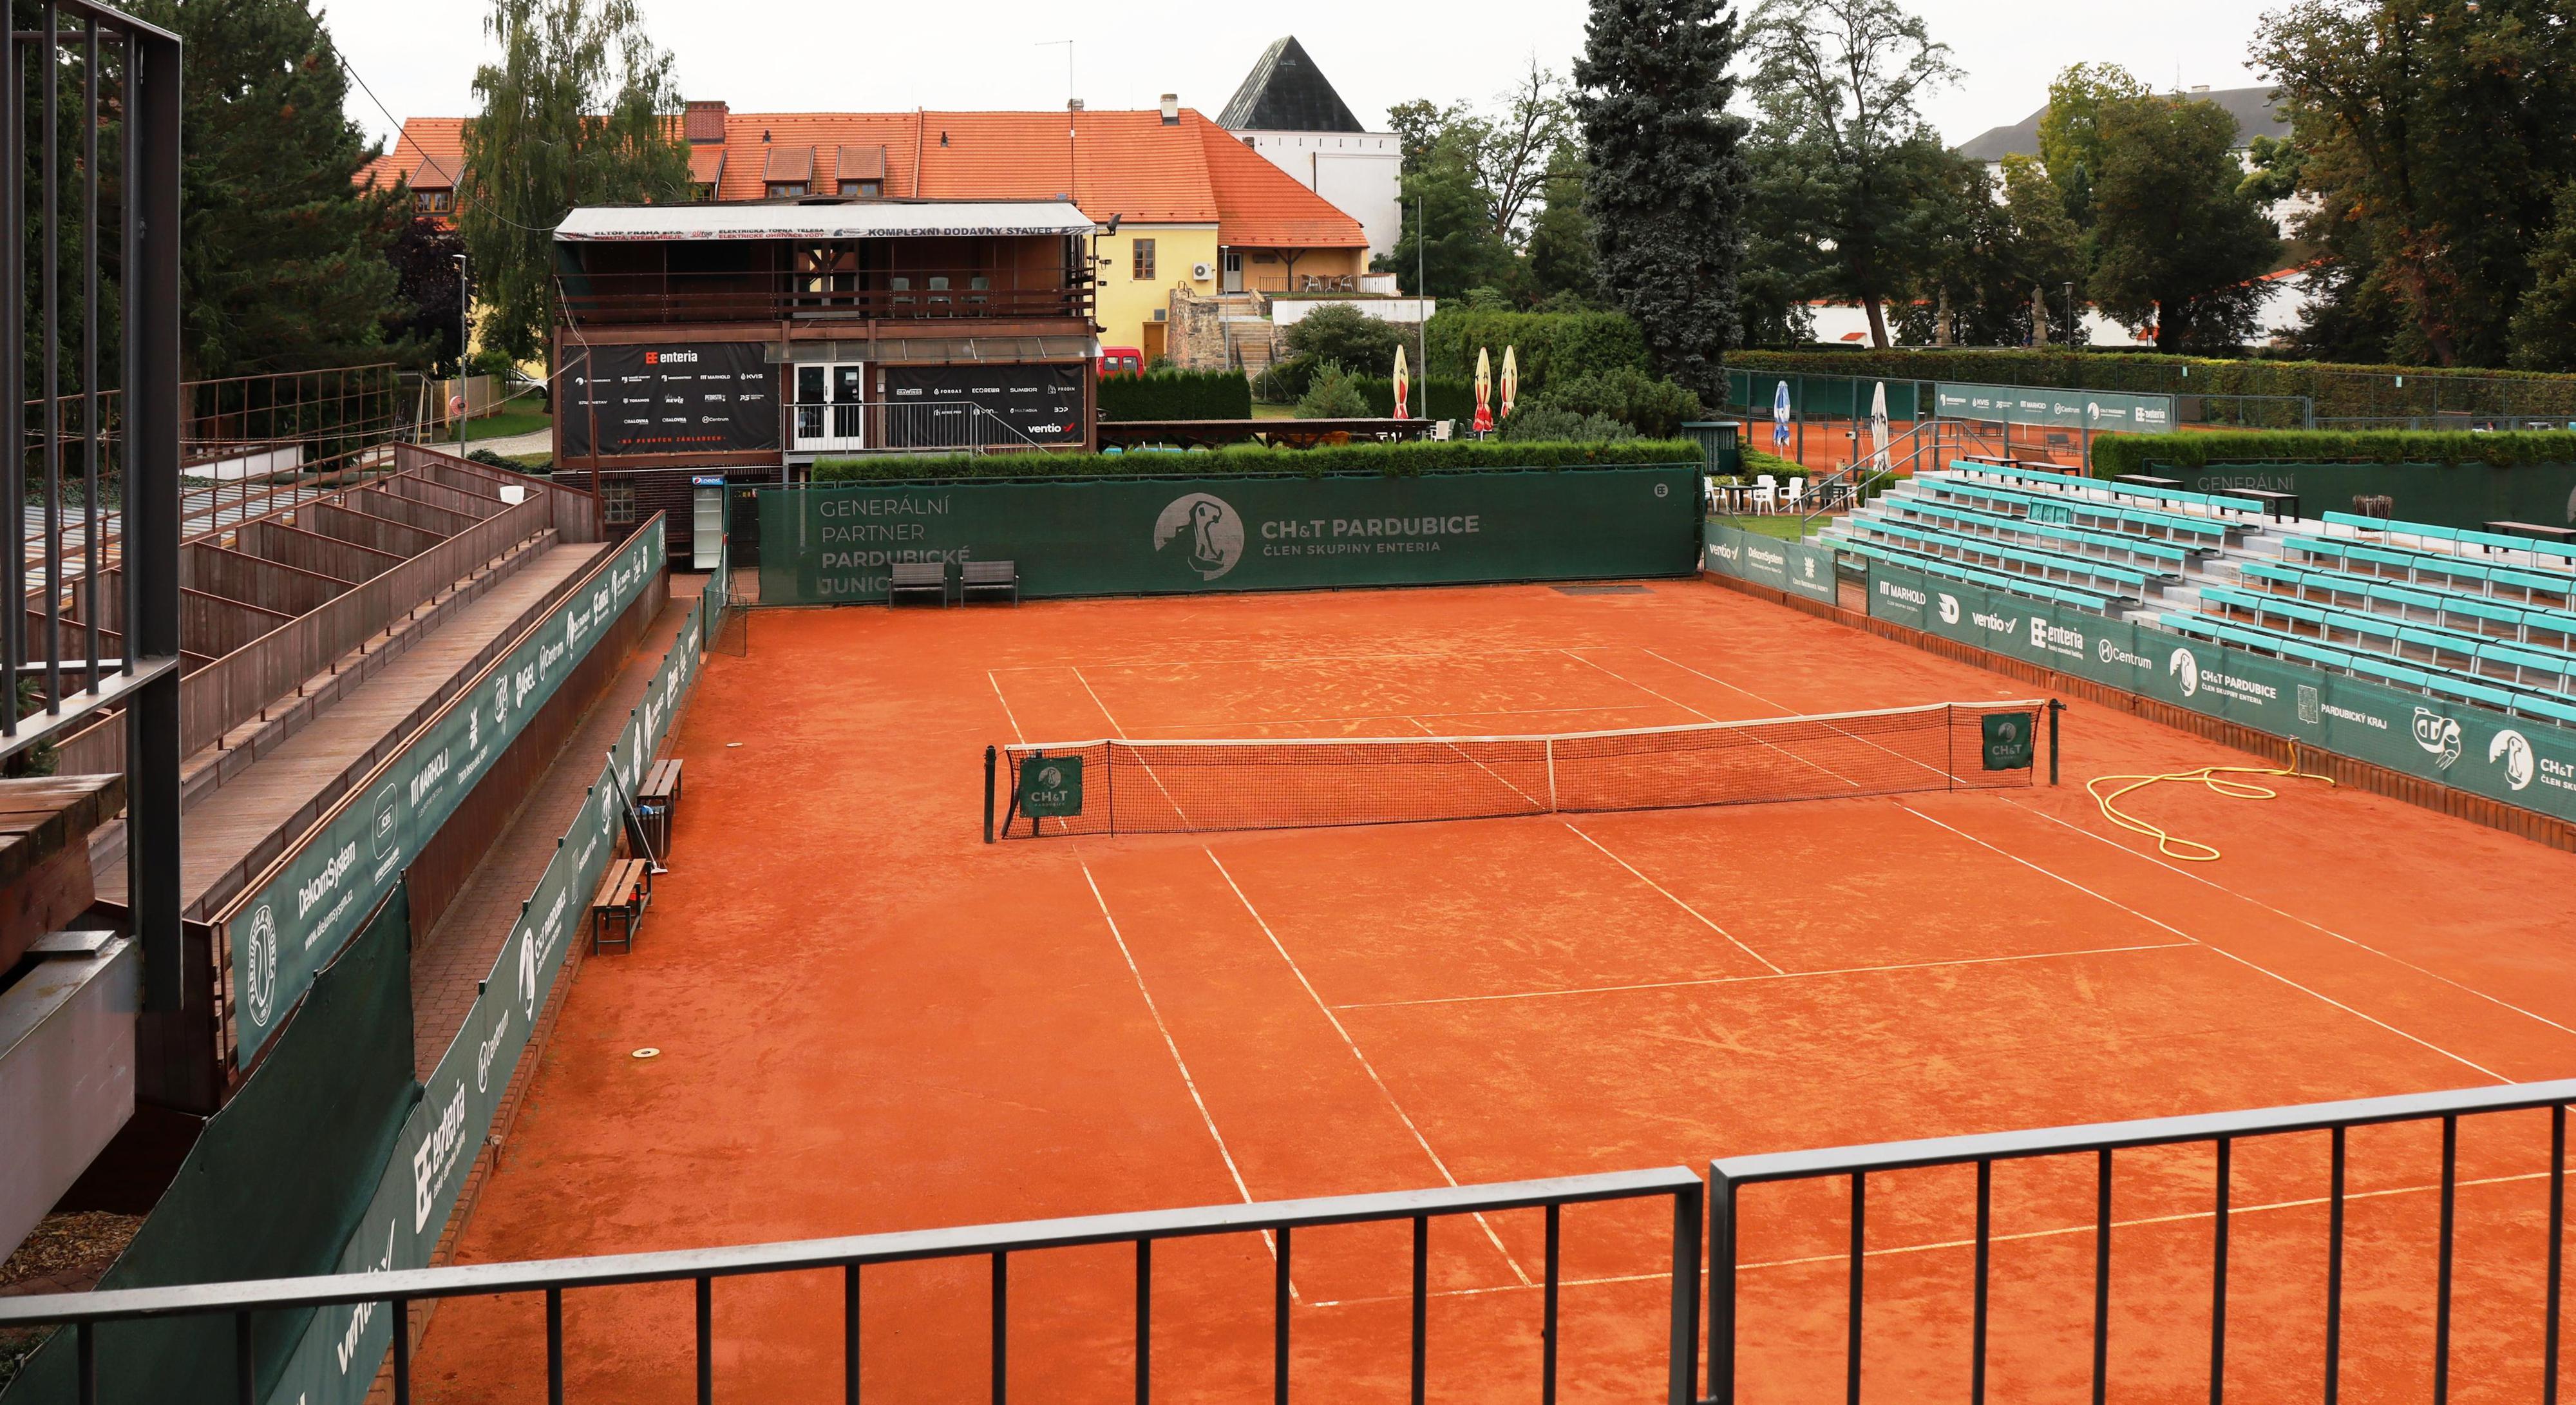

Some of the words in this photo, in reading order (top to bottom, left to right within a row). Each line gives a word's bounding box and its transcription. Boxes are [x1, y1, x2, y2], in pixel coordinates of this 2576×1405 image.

[660, 350, 697, 363] enteria
[1027, 423, 1061, 433] ventio
[820, 495, 950, 517] GENERÁLNÍ
[822, 524, 925, 542] PARTNER
[1261, 520, 1325, 539] CH&T
[1332, 515, 1480, 537] PARDUBICE
[1263, 544, 1302, 557] ČLEN
[1307, 543, 1372, 555] SKUPINY
[1377, 542, 1441, 553] ENTERIA
[1891, 585, 1926, 605] MARHOLD
[1972, 612, 2004, 632] ventio
[2048, 626, 2083, 649] enteria
[2113, 647, 2152, 669] Centrum
[2201, 670, 2224, 685] CH&T
[2224, 674, 2277, 699] PARDUBICE
[2321, 703, 2365, 724] PARDUBICKÝ
[2367, 716, 2387, 729] KRAJ
[1993, 744, 2022, 755] CH&T
[2541, 758, 2575, 778] CH&T
[2541, 774, 2561, 787] ČLEN
[1031, 790, 1068, 802] CH&T
[299, 841, 355, 920] DekomSystem
[432, 1078, 465, 1174] enteria
